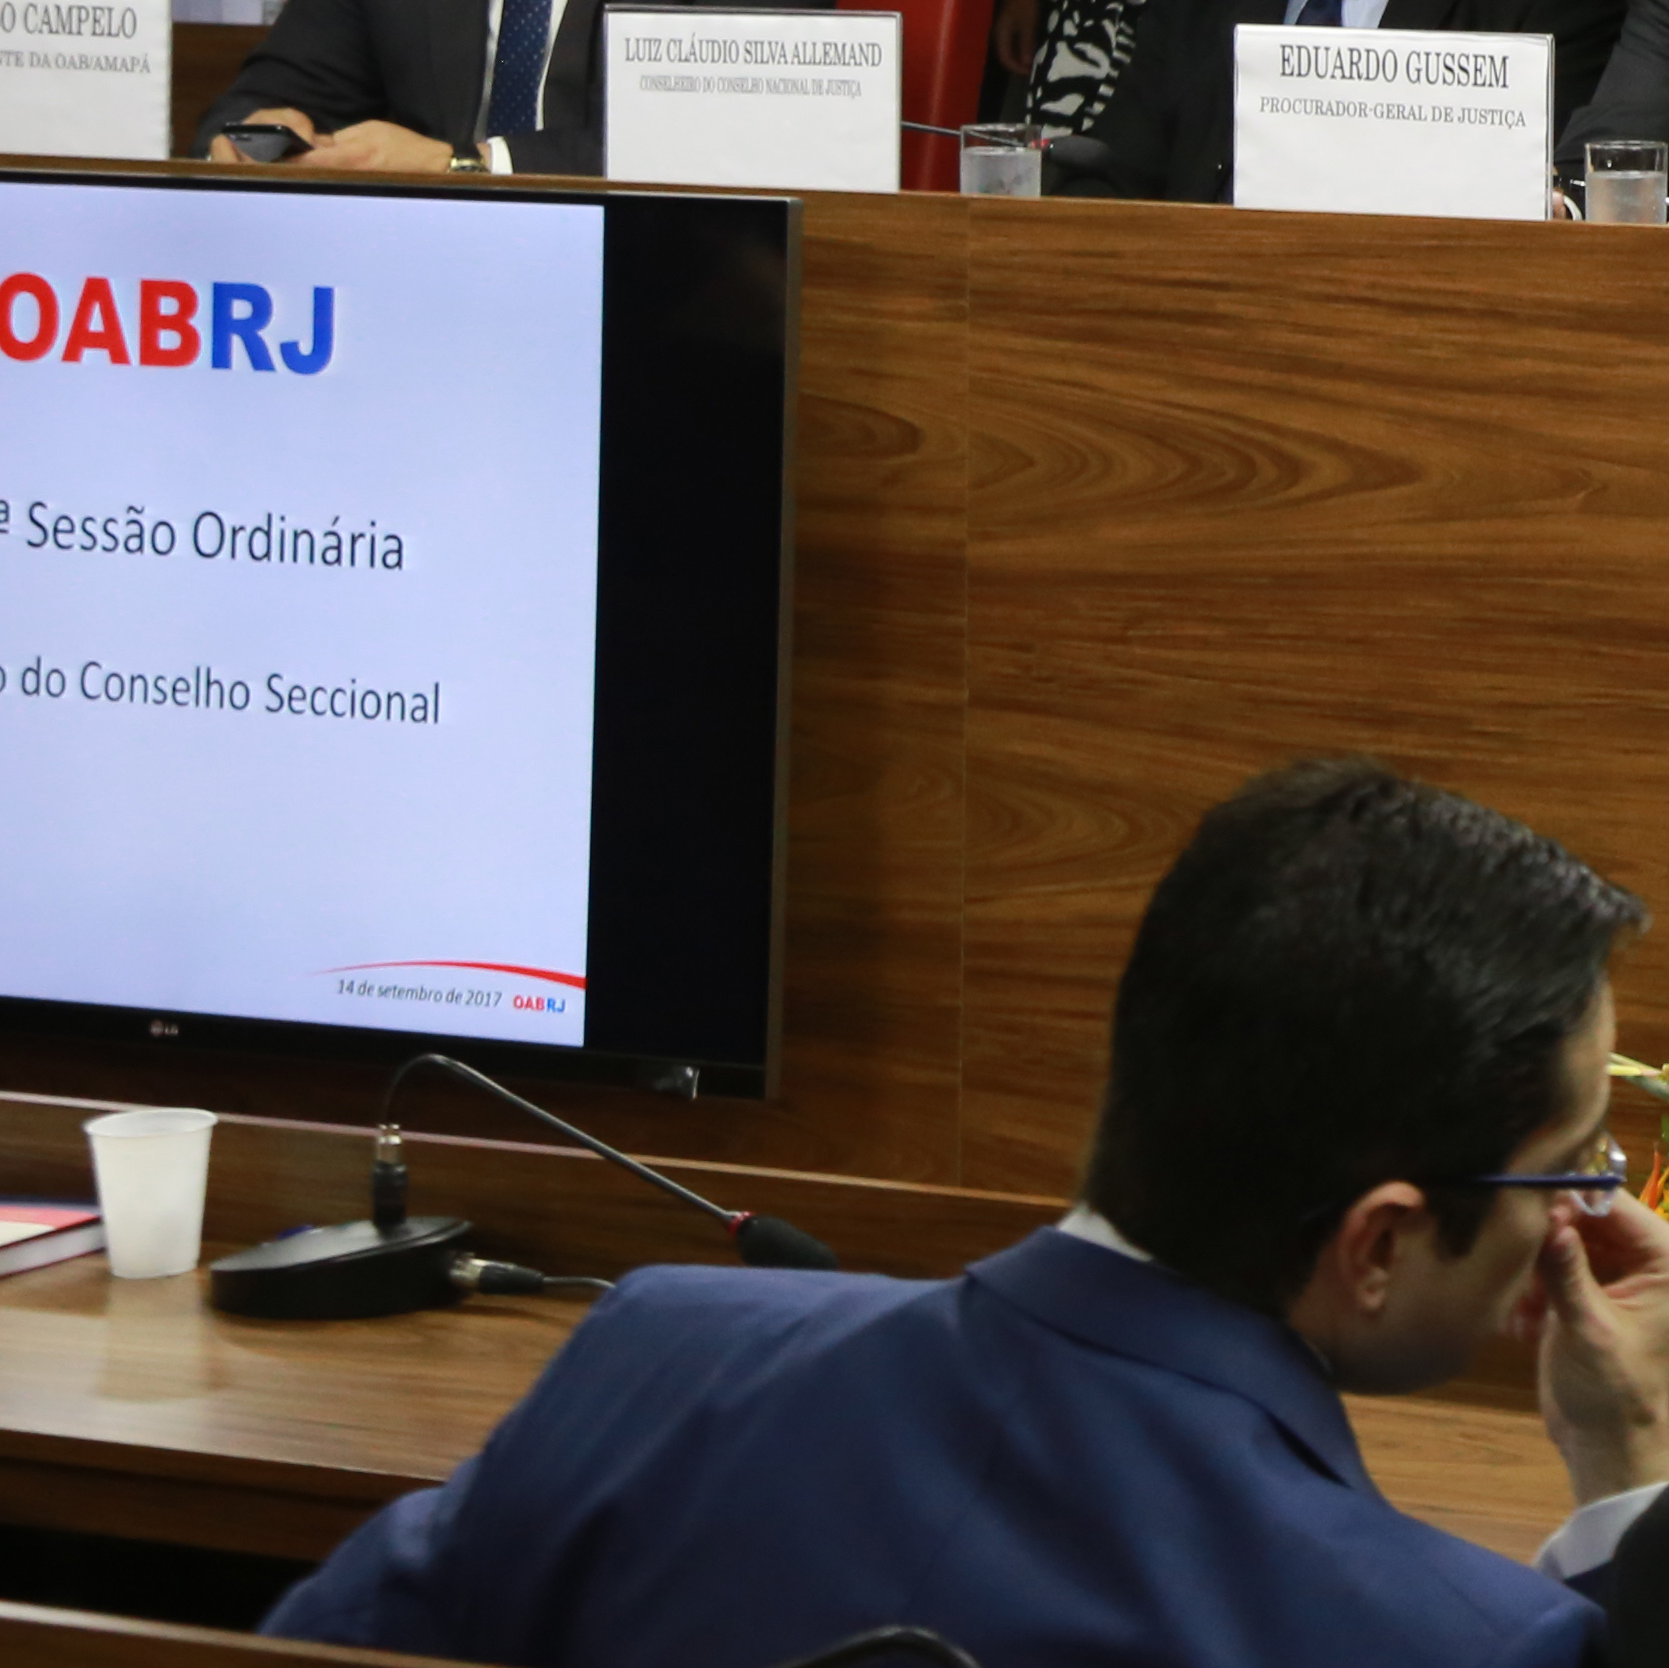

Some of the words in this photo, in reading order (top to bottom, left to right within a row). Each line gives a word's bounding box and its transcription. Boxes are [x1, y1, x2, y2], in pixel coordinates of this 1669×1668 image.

[24, 3, 138, 39] CAMPELO
[29, 52, 51, 68] DA
[55, 53, 151, 74] OAB/AMAPÁ
[625, 37, 662, 62] LUIZ
[666, 32, 740, 64] CLÁUDIO
[743, 40, 788, 65] SILVA
[791, 41, 882, 67] ALLEMAND
[1280, 44, 1398, 83] EDUARDO
[1406, 50, 1509, 89] GUSSEM
[1260, 96, 1427, 122] PROCURADOR-GERAL
[1432, 106, 1454, 123] DE
[1457, 108, 1526, 129] JUSTIÇA
[0, 272, 335, 375] OABRJ
[26, 501, 176, 556] Sessão
[193, 511, 403, 569] Ordinária
[21, 655, 66, 698] do
[80, 661, 251, 711] Conselho
[265, 672, 440, 724] Seccional
[337, 979, 354, 995] 14
[357, 980, 374, 997] de
[377, 984, 443, 1003] setembro
[446, 988, 463, 1004] de
[465, 990, 502, 1007] 2017
[513, 995, 566, 1013] OABRJ
